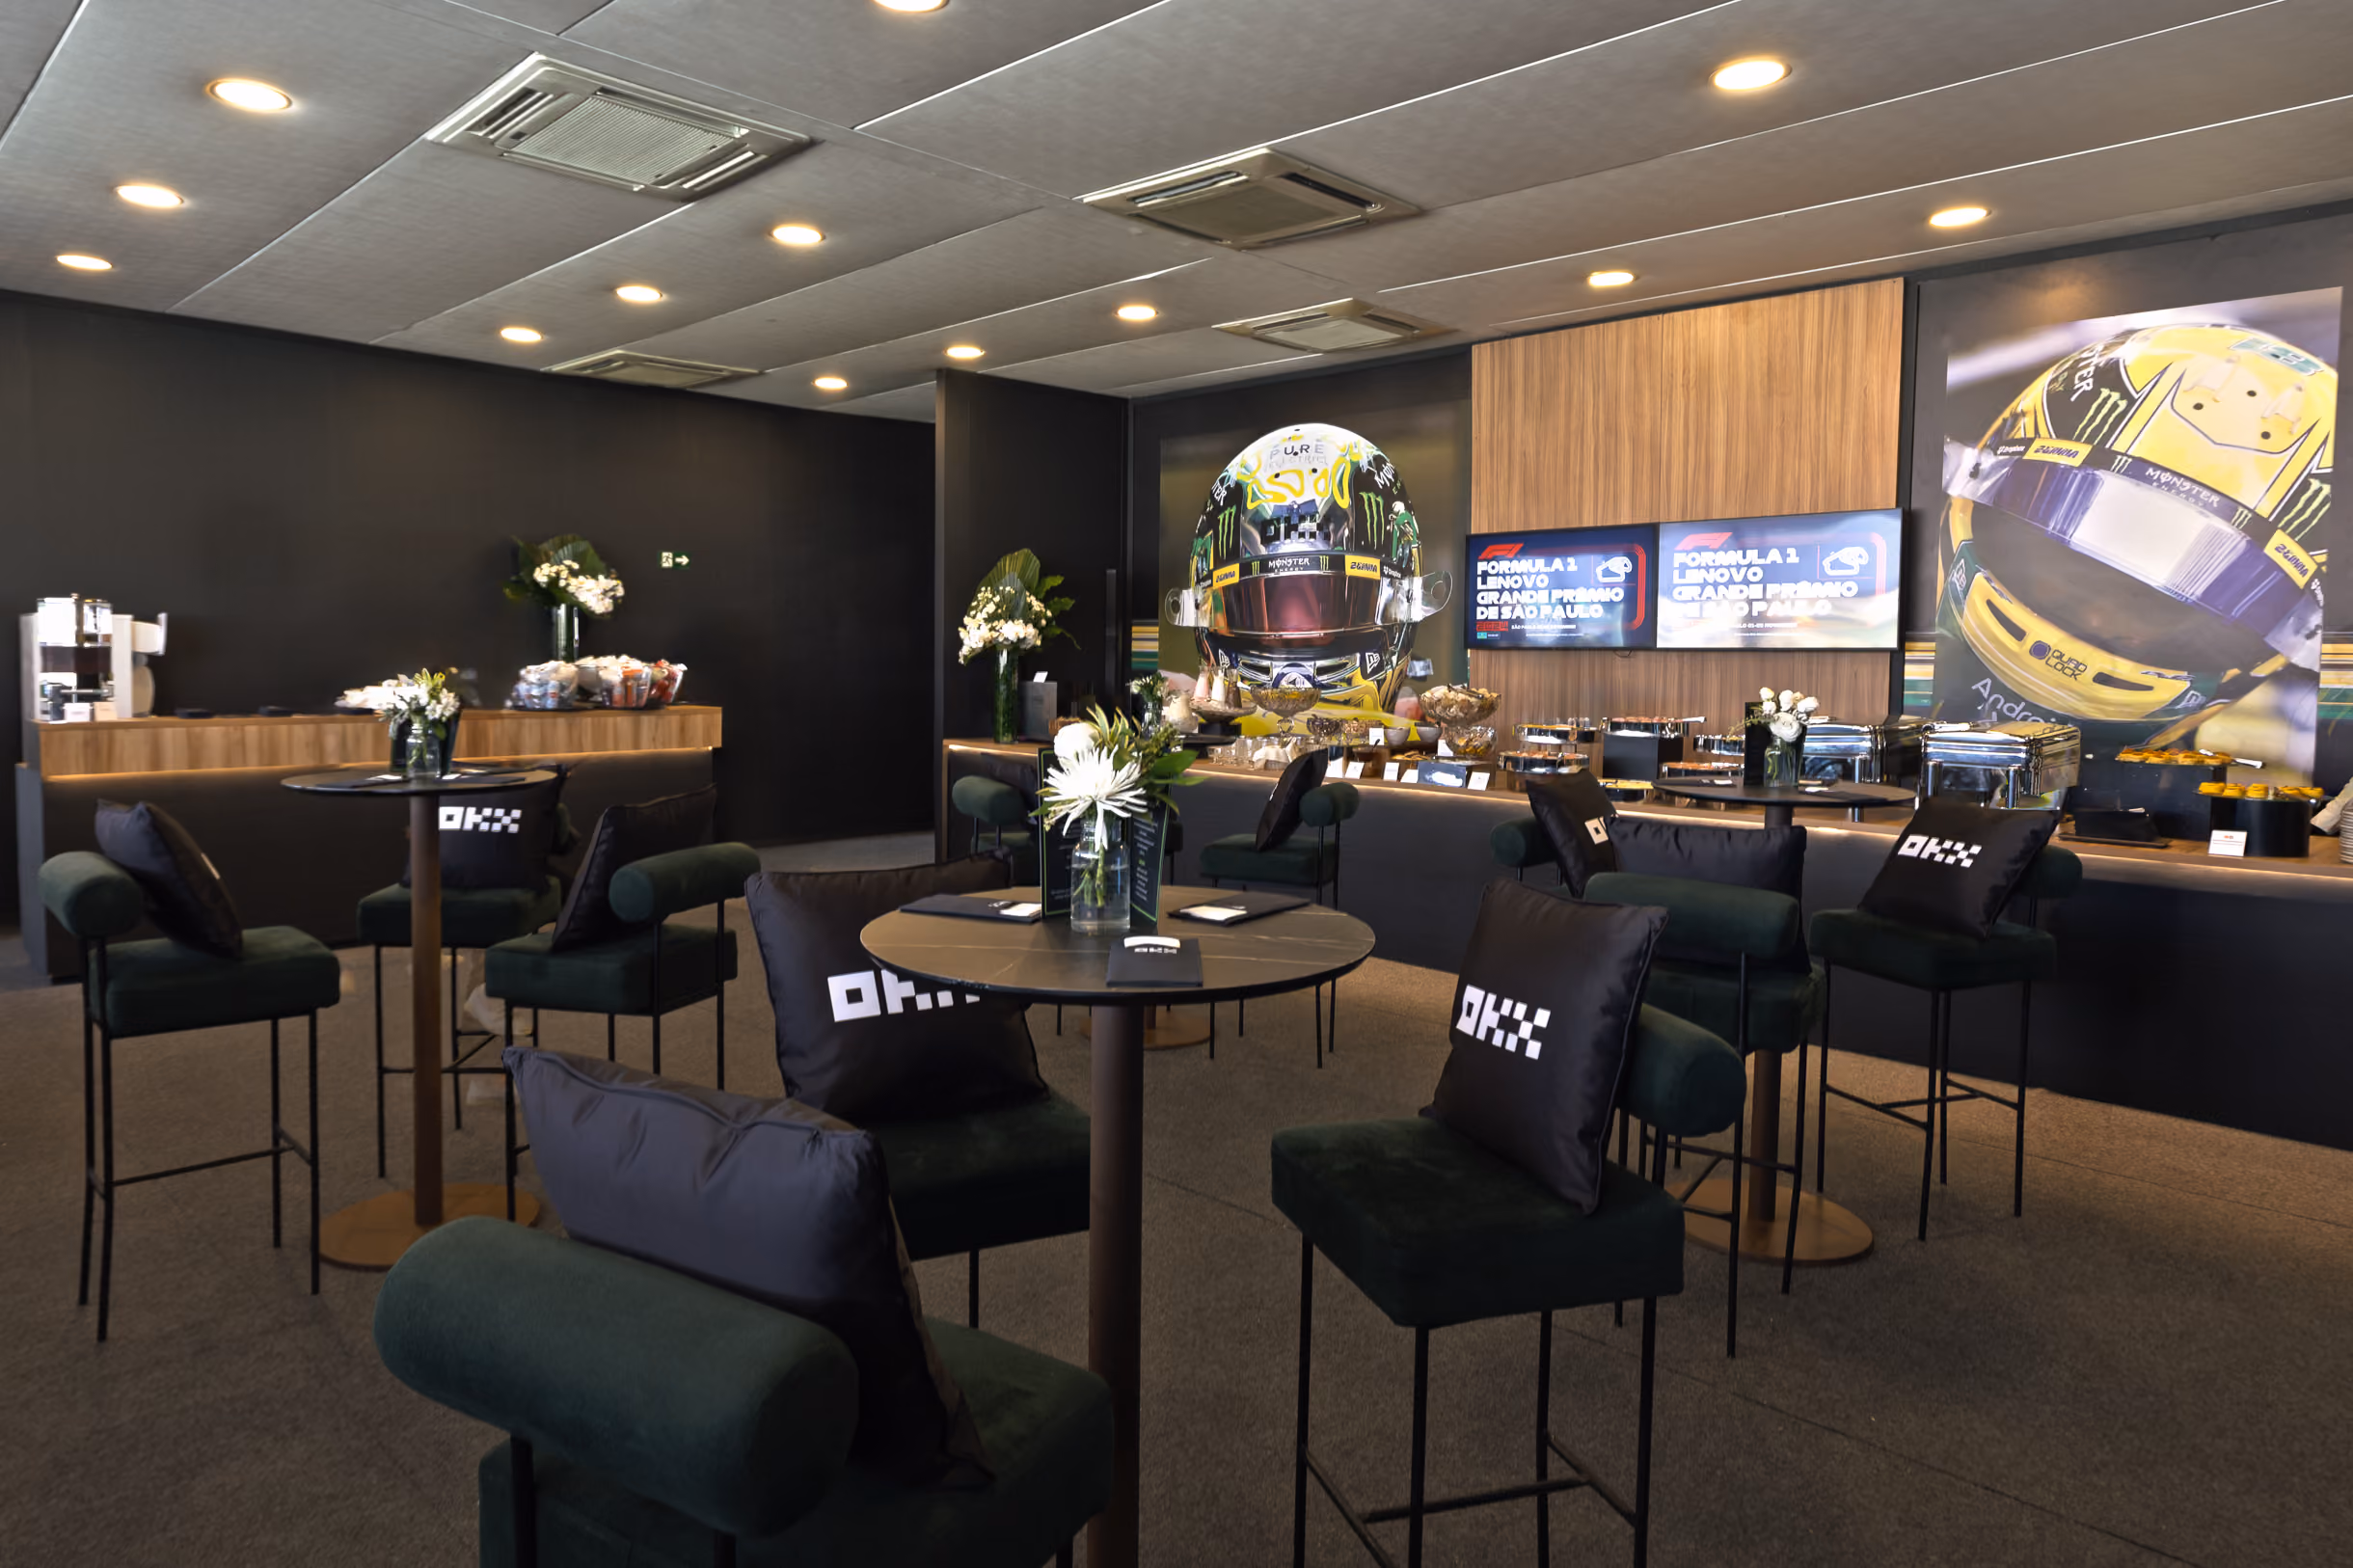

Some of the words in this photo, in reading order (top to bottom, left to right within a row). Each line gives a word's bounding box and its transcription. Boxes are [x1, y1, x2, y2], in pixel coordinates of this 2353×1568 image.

[1270, 444, 1325, 460] PURE
[2146, 468, 2221, 507] MONSTER
[1269, 557, 1311, 568] MONSTER
[1476, 557, 1564, 575] FORMULA
[1567, 557, 1578, 572] 1
[1673, 548, 1783, 567] FORMULA
[1786, 548, 1799, 563] 1
[1476, 575, 1550, 590] LENOVO
[1673, 566, 1764, 584] LENOVO
[1476, 589, 1550, 605] GRANDE
[1672, 583, 1764, 601] GRANDE
[1476, 606, 1500, 620] DE
[1501, 603, 1538, 620] SÃO
[1540, 604, 1604, 619] PAULO
[2045, 656, 2082, 681] LOCK
[2051, 649, 2088, 673] QUAD
[439, 806, 522, 833] OKX
[1897, 834, 1982, 868] OKX
[827, 969, 981, 1022] OK
[1455, 984, 1552, 1061] OKX
